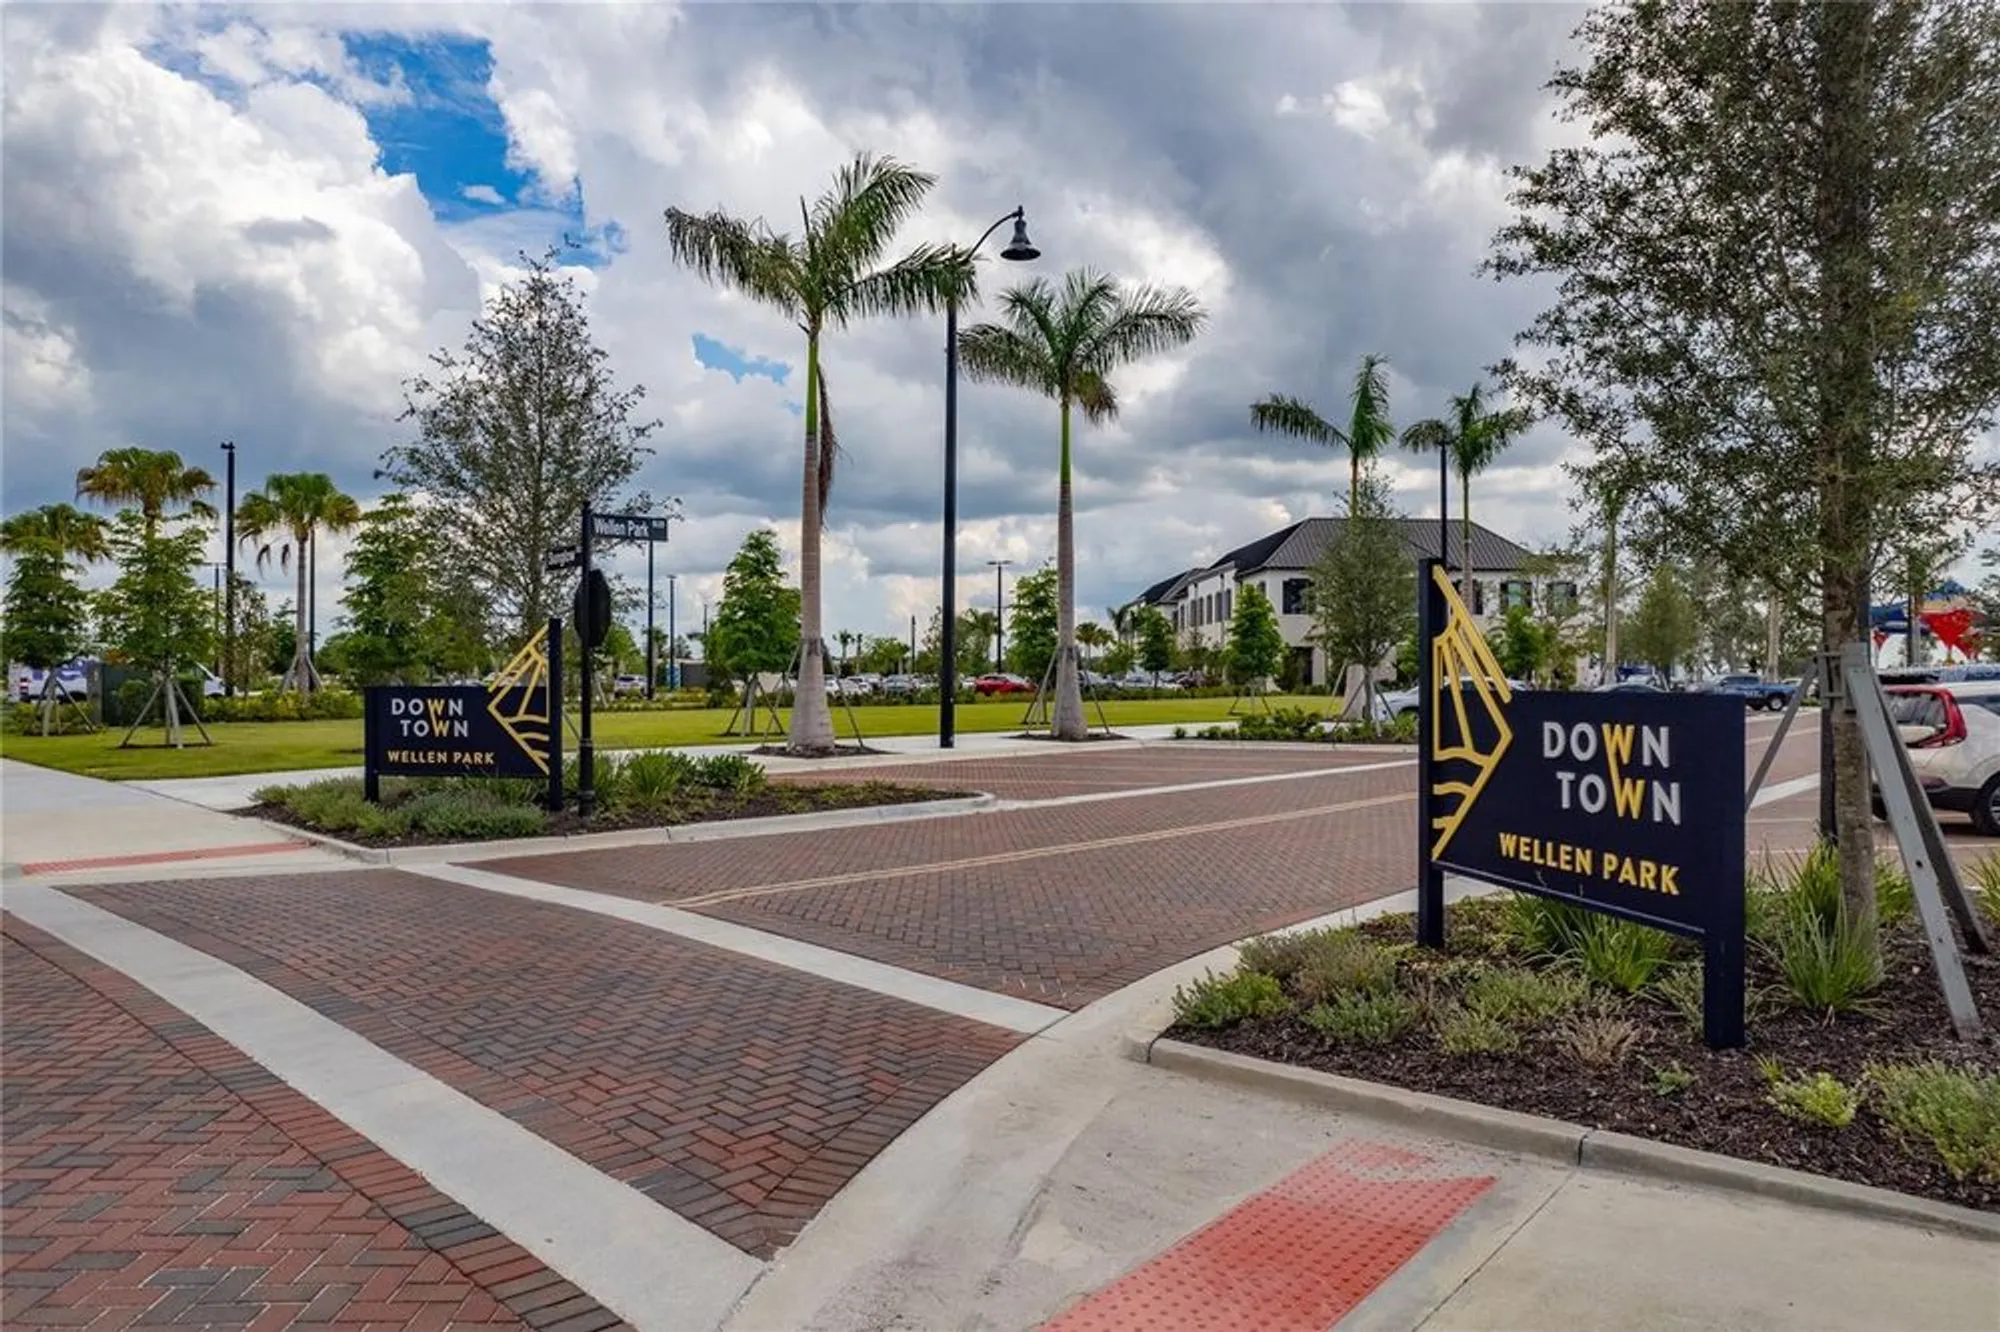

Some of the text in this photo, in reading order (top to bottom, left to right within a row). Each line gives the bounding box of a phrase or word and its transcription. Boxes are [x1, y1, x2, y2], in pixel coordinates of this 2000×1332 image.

[593, 517, 625, 535] Wellen
[628, 519, 649, 537] Park
[391, 698, 463, 716] DOWN
[400, 719, 468, 737] TOWN
[1542, 721, 1670, 768] DOWN
[387, 750, 495, 765] WELLEN PARK
[1556, 771, 1681, 825] TOWN
[1499, 832, 1680, 896] WELLEN PARK
